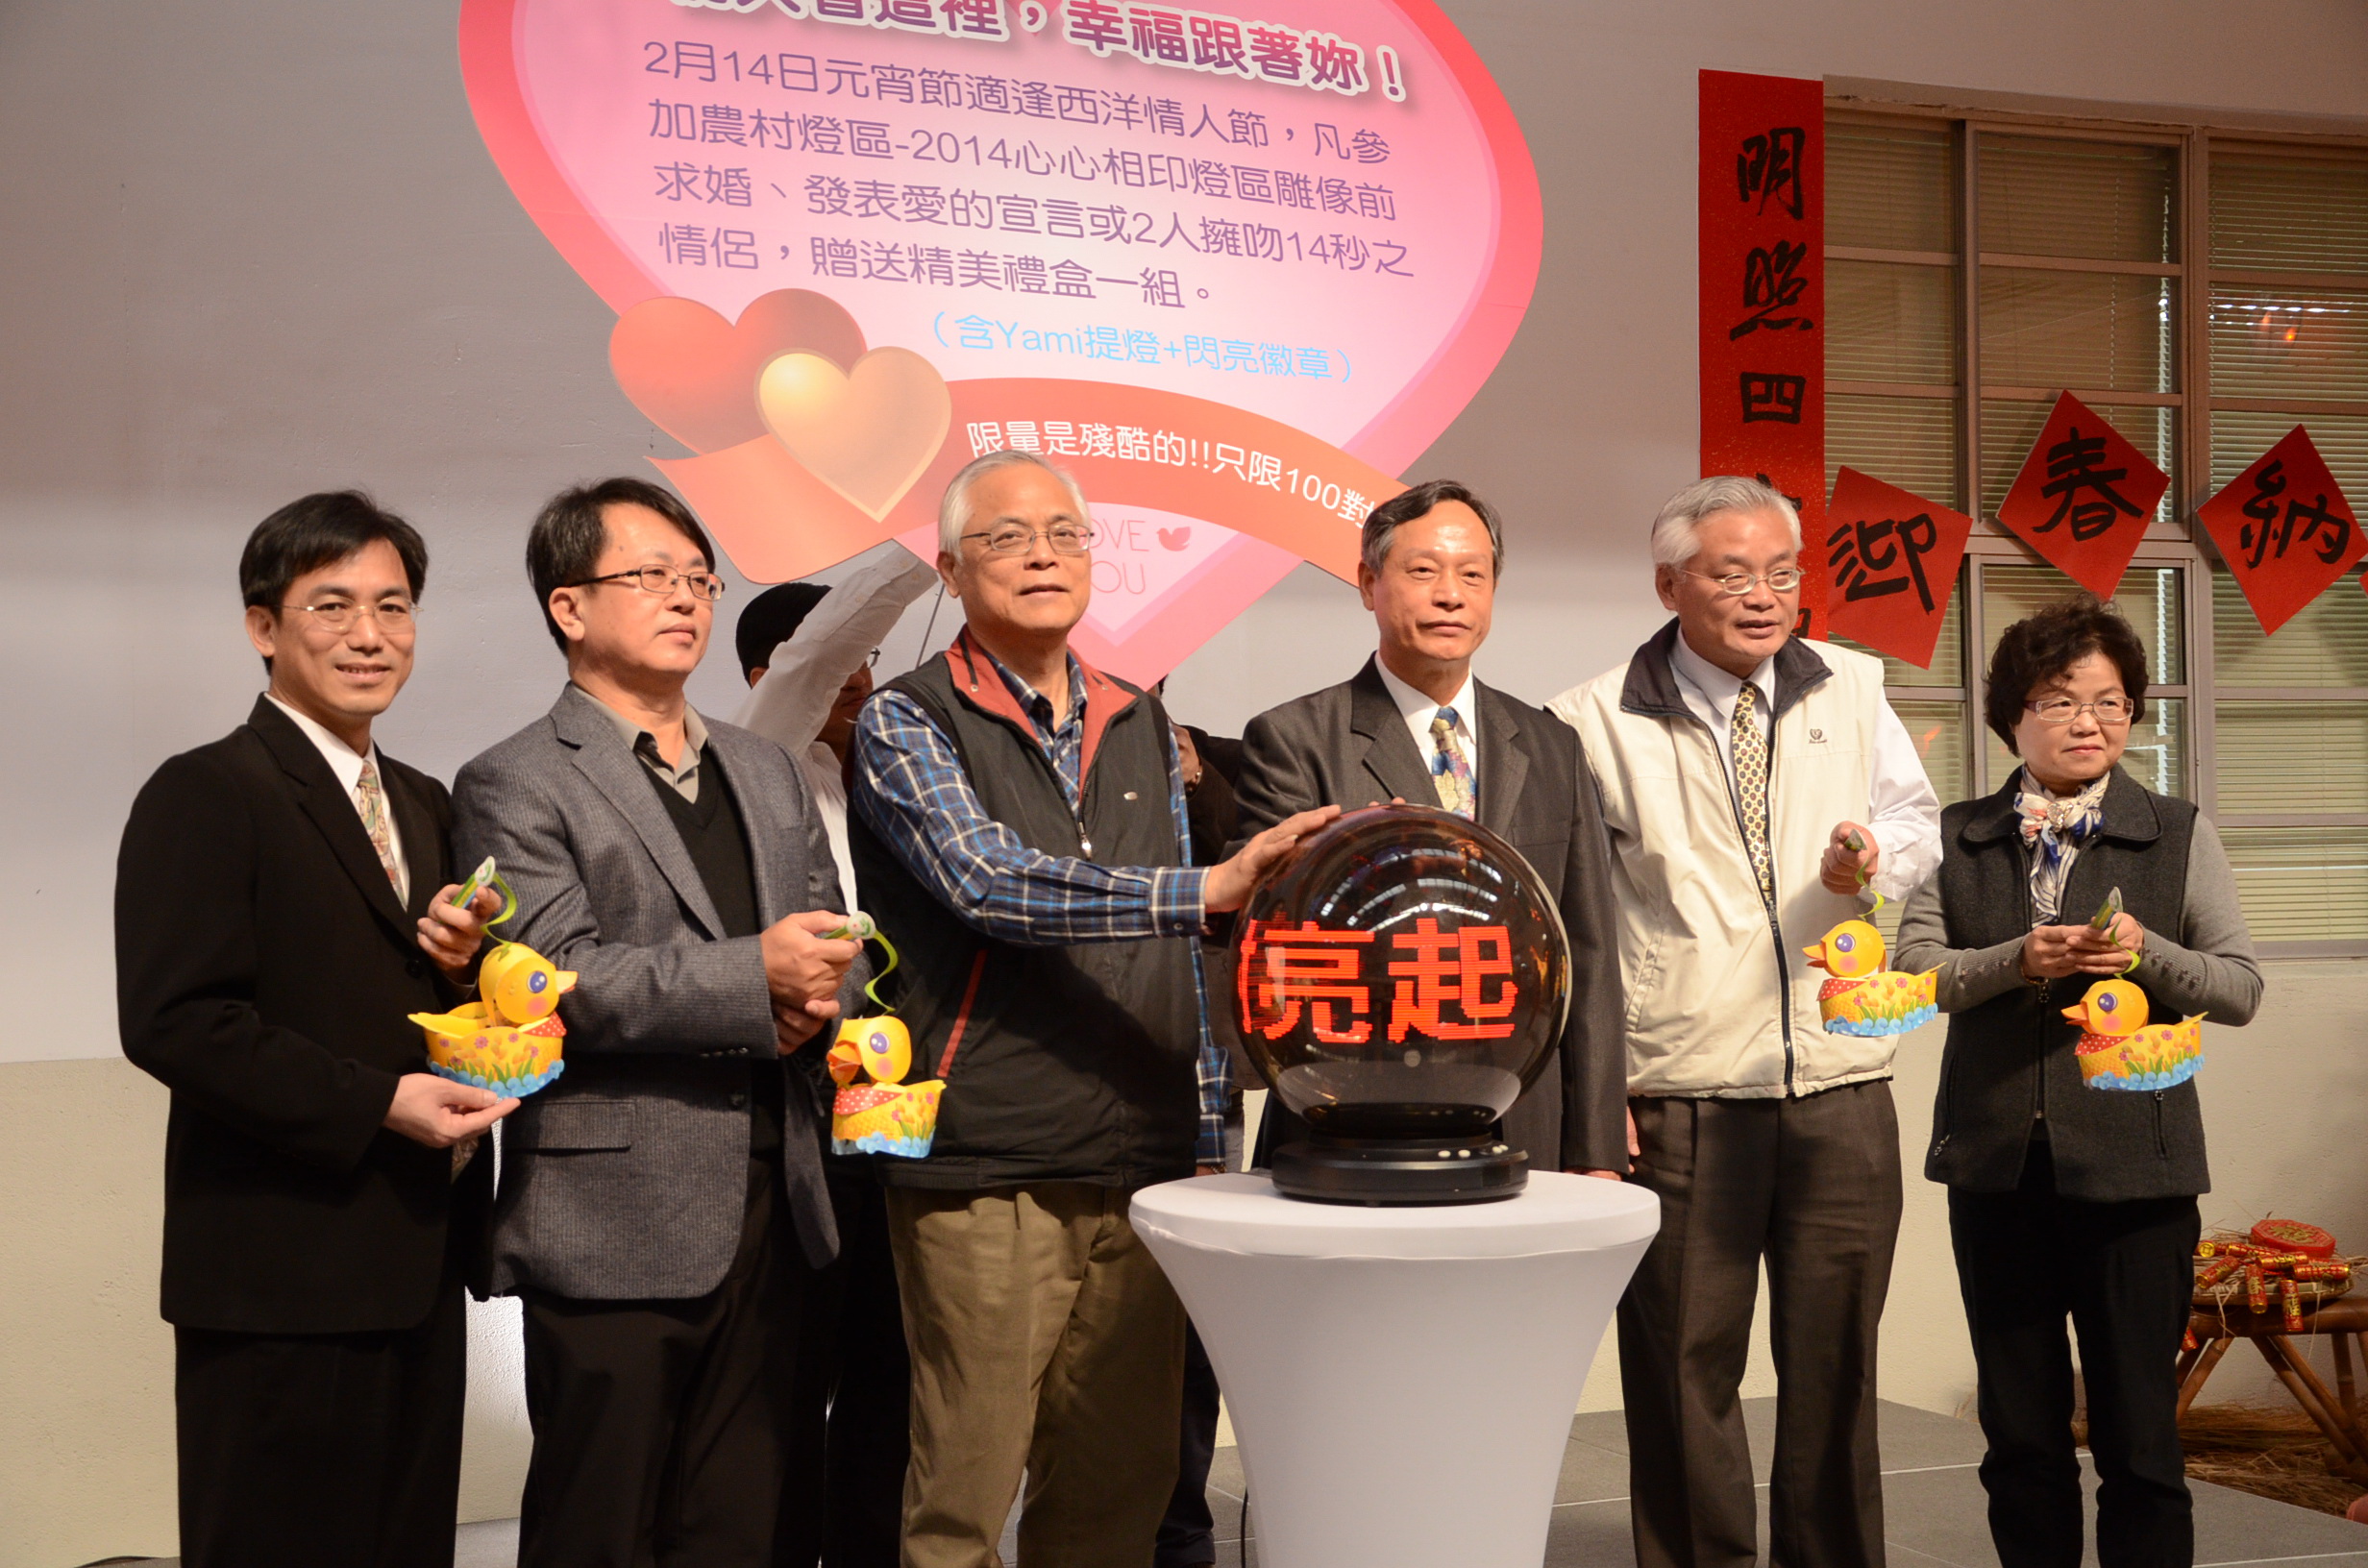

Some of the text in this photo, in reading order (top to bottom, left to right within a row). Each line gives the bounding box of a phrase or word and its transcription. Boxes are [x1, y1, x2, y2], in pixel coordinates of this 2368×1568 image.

[688, 0, 1403, 97] 這裡，幸福跟著妳！
[1730, 126, 1813, 638] 明照四
[2033, 426, 2145, 542] 春
[2240, 458, 2351, 570] 納
[1090, 560, 1146, 595] OU
[1827, 513, 1936, 616] 迎
[1239, 917, 1518, 1044] 亮起
